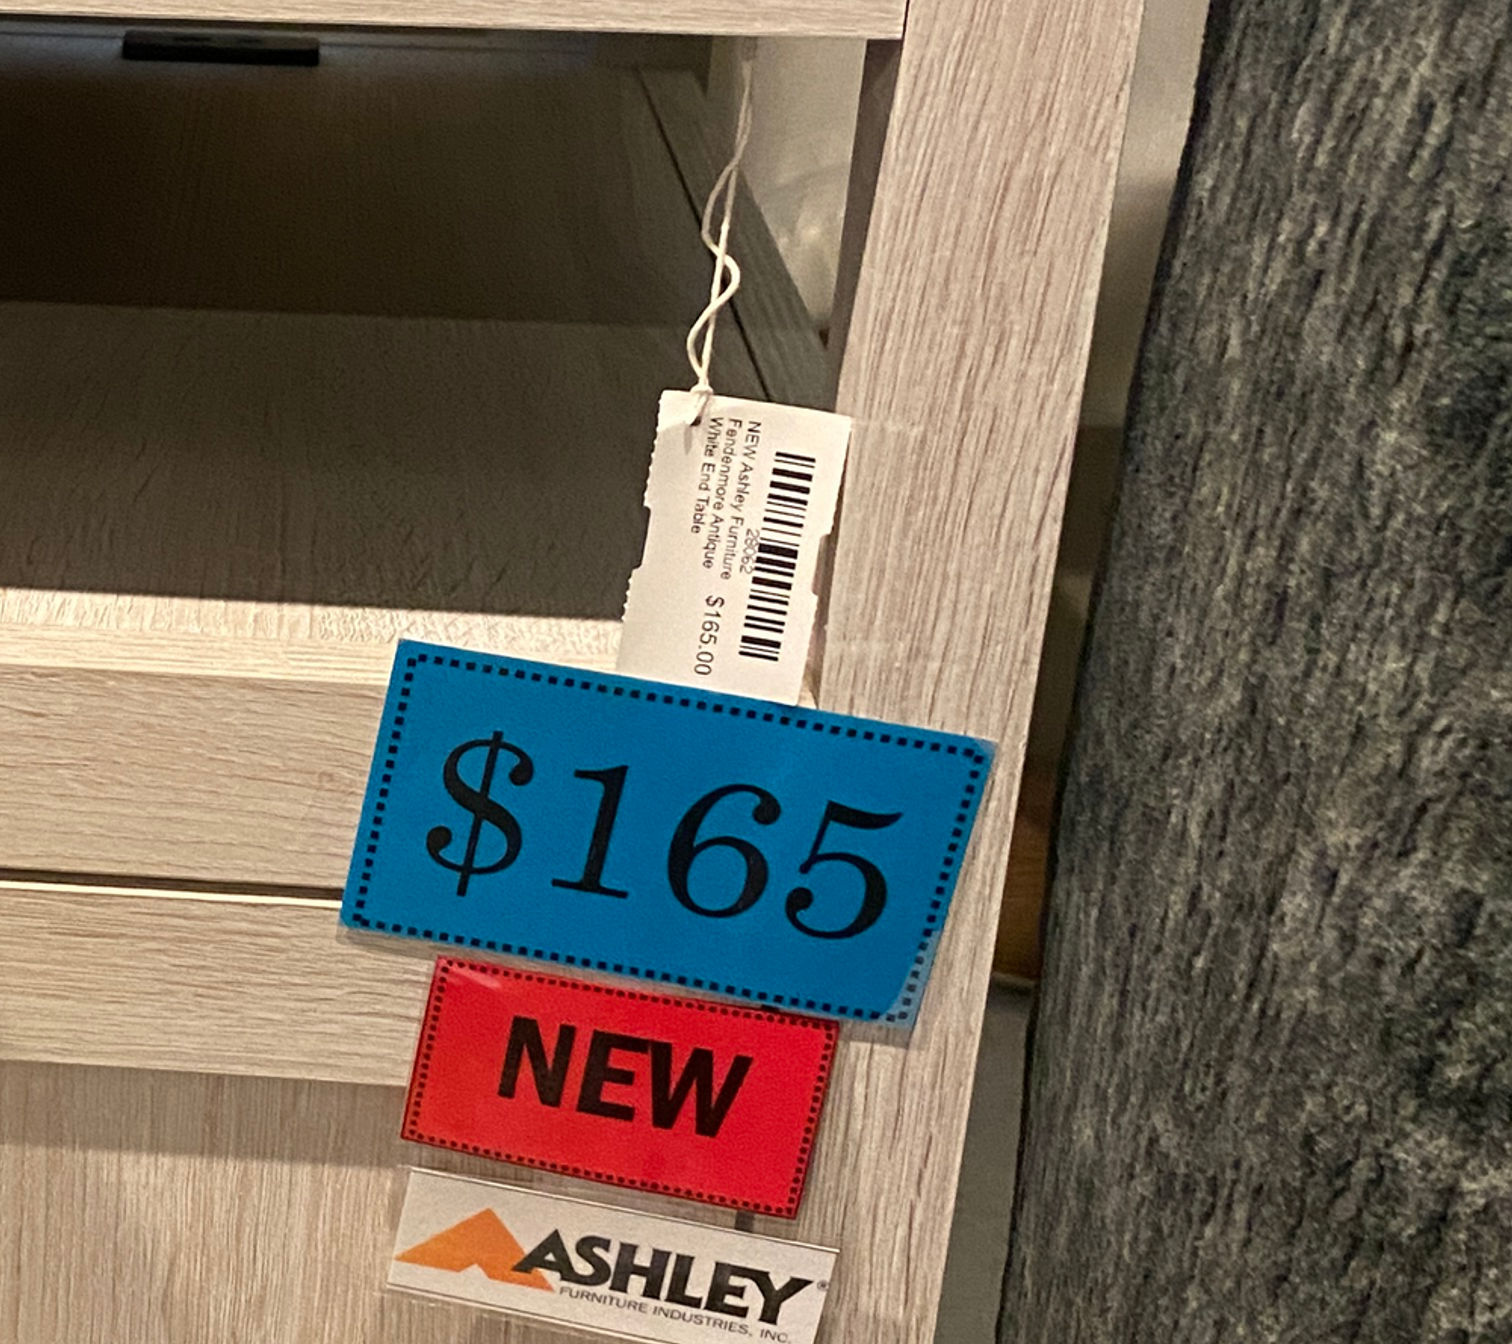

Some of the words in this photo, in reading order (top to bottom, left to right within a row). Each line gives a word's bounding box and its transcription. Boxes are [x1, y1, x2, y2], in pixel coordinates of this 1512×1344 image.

[704, 417, 723, 457] White
[712, 418, 742, 510] Fendenmore
[742, 421, 762, 461] NEW
[698, 463, 715, 491] End
[731, 462, 754, 512] Ashley
[691, 497, 708, 534] Table
[702, 514, 724, 569] Antique
[720, 516, 744, 580] Furniture
[694, 595, 724, 676] $165.00
[426, 731, 903, 939] $165
[498, 1015, 754, 1138] NEW
[511, 1228, 814, 1326] ASHLEY
[559, 1286, 648, 1315] FURNITURE
[759, 1327, 792, 1344] INC.
